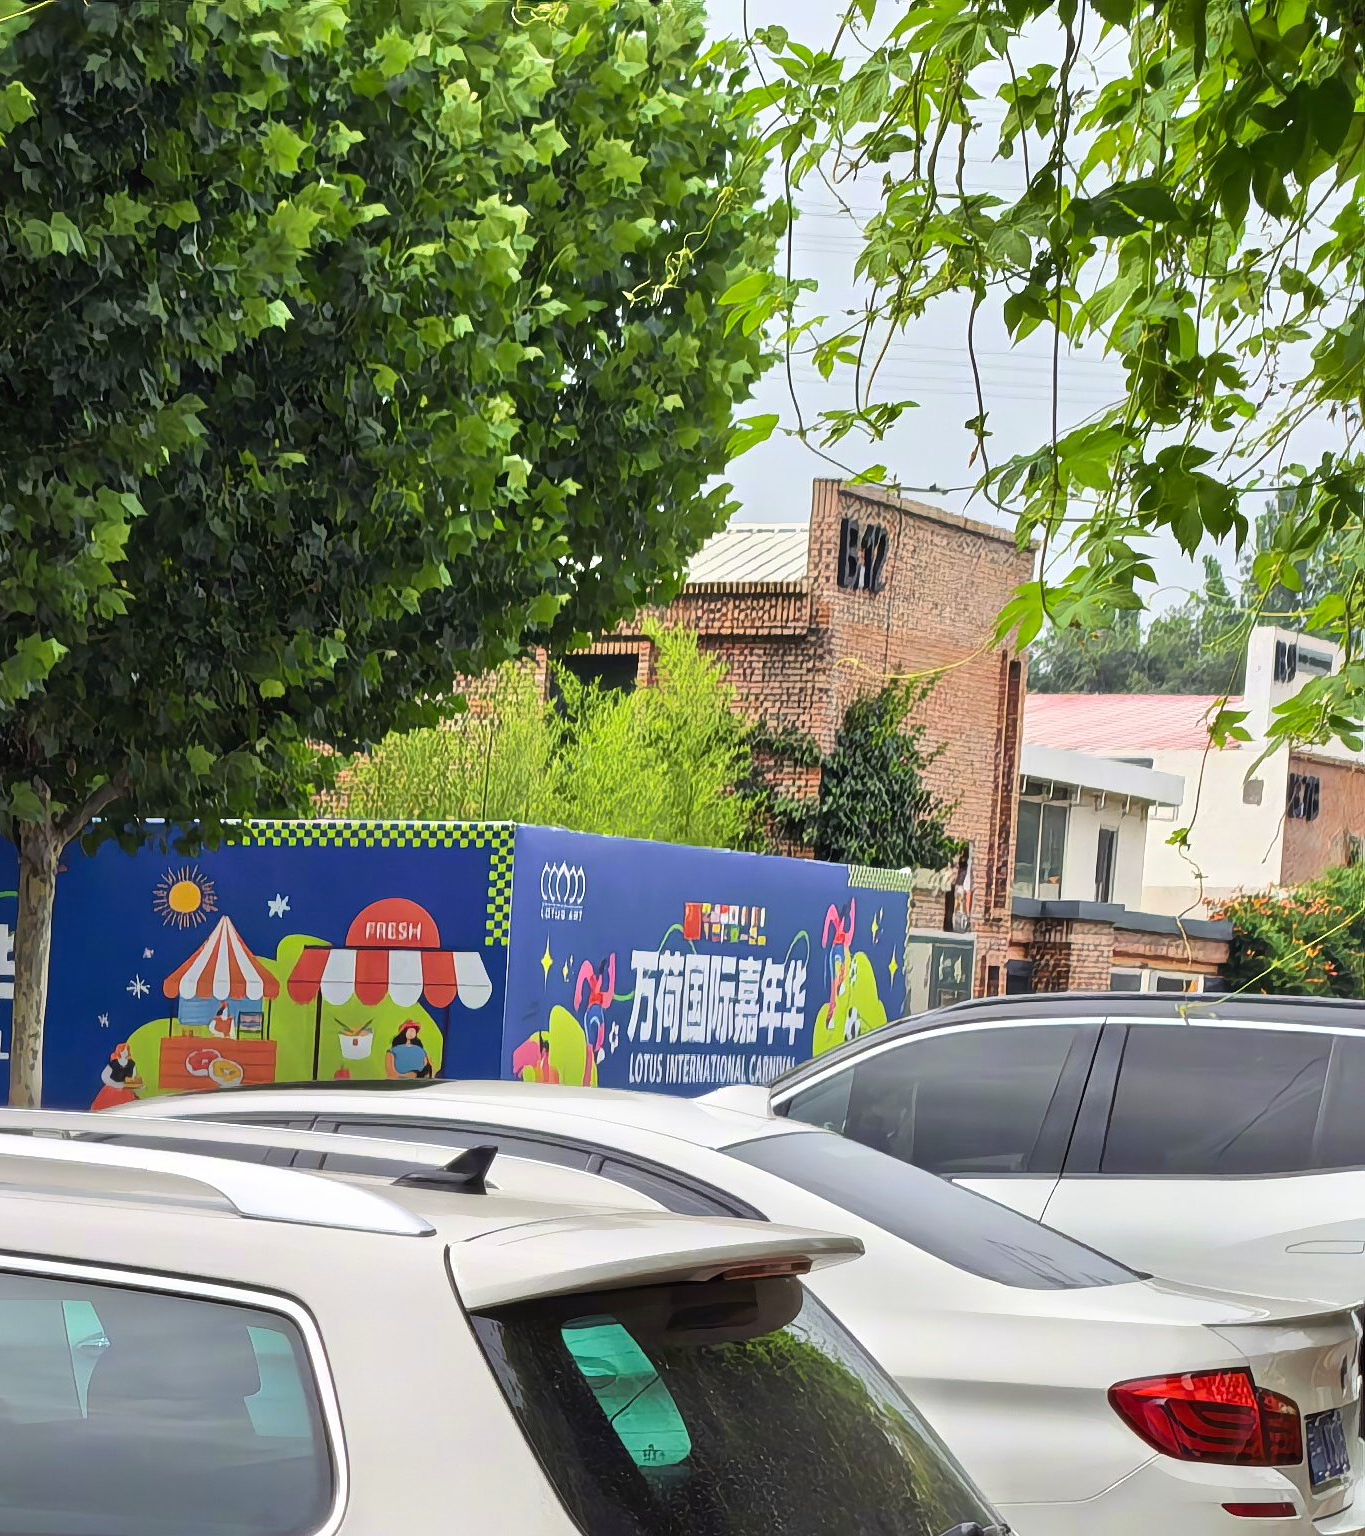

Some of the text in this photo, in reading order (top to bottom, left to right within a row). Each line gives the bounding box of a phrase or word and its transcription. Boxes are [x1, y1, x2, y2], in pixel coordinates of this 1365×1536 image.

[366, 922, 421, 940] FRESH
[627, 949, 808, 1045] 万荷国际嘉年华
[629, 1053, 663, 1084] LOTUS
[666, 1053, 746, 1084] INTERNATIONAL
